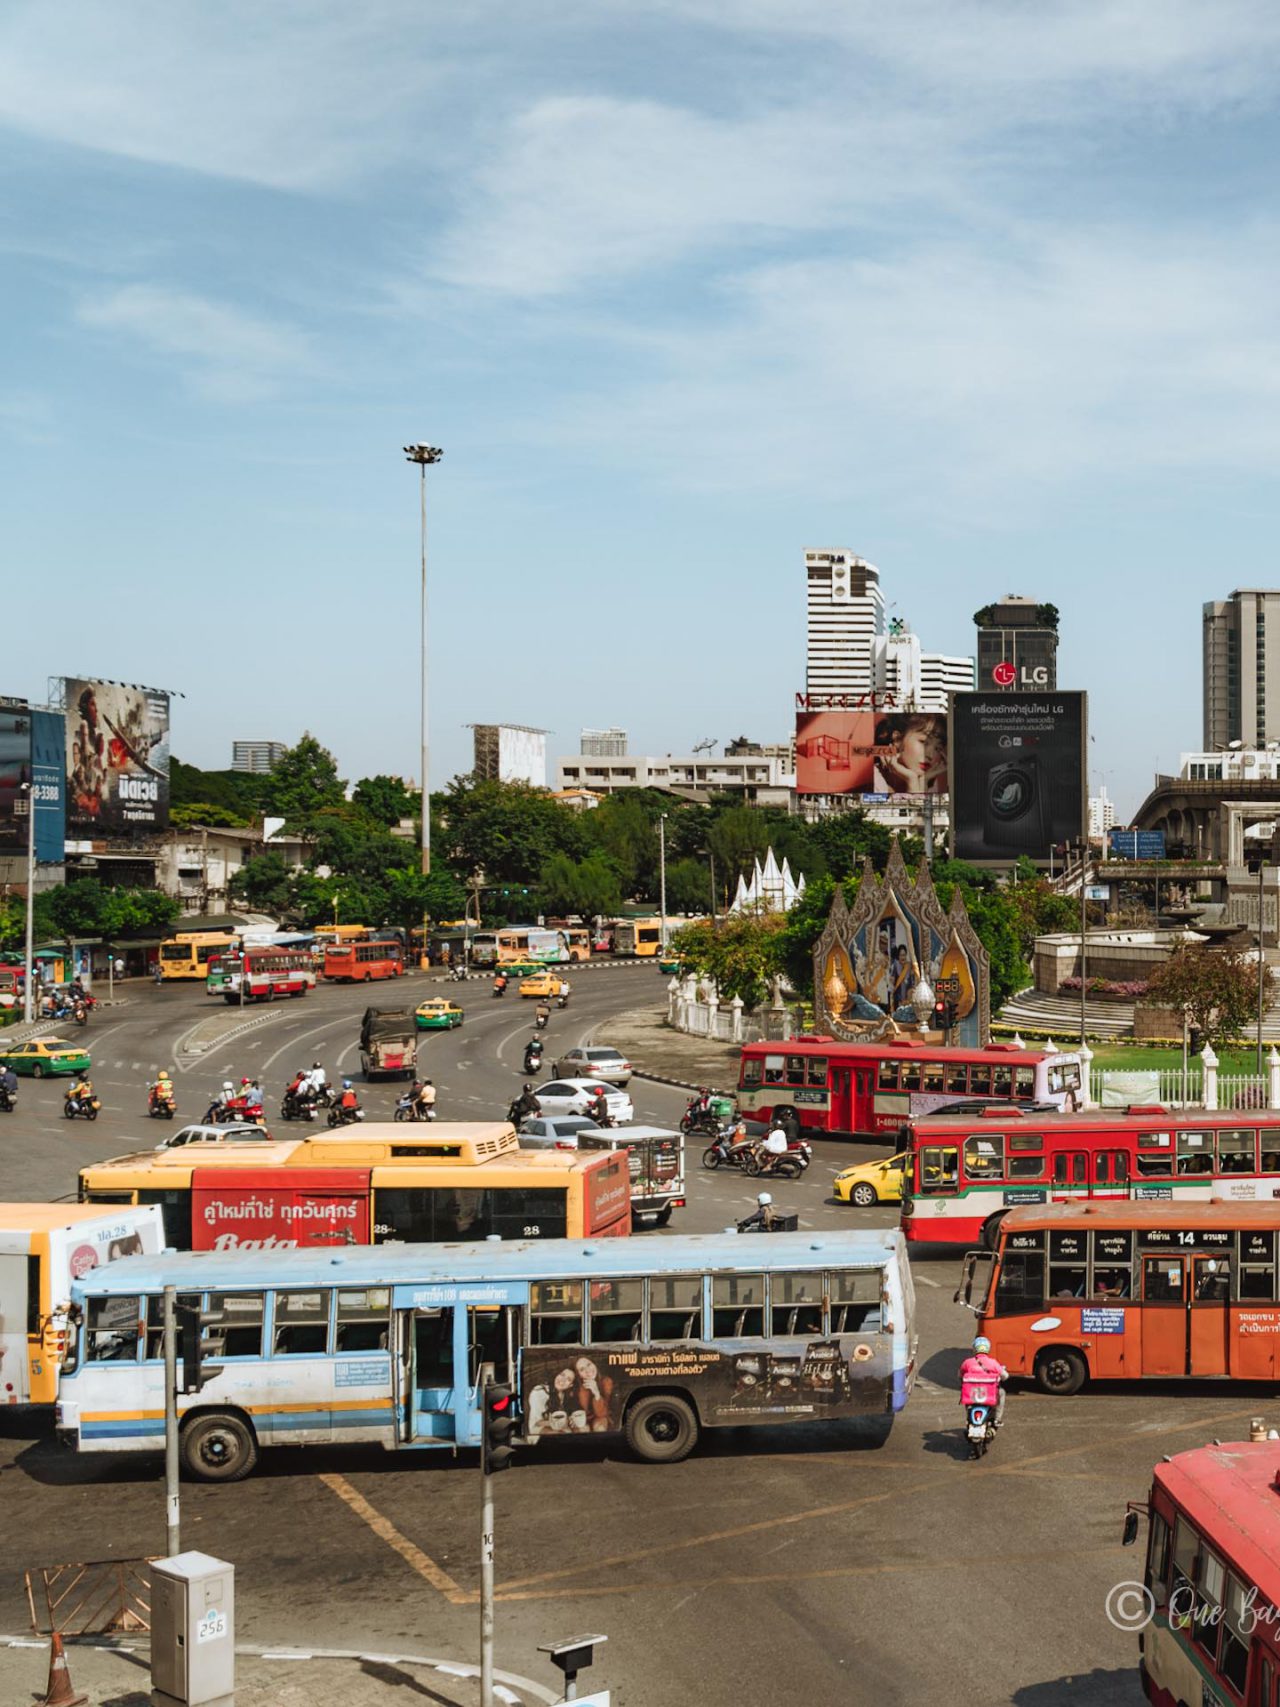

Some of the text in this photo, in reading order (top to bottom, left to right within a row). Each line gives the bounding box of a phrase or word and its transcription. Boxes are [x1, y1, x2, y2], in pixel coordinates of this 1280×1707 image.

[1021, 666, 1048, 684] LG
[796, 691, 897, 708] MERREZCA
[1053, 705, 1064, 713] LG
[204, 1195, 358, 1225] คู่ใหม่ที่ใช่ ทุกวันศุกร์
[524, 1225, 540, 1236] 28
[1177, 1231, 1195, 1245] 14
[211, 1232, 299, 1251] Bata
[608, 1352, 637, 1365] กาแฟ
[199, 1619, 224, 1638] 256
